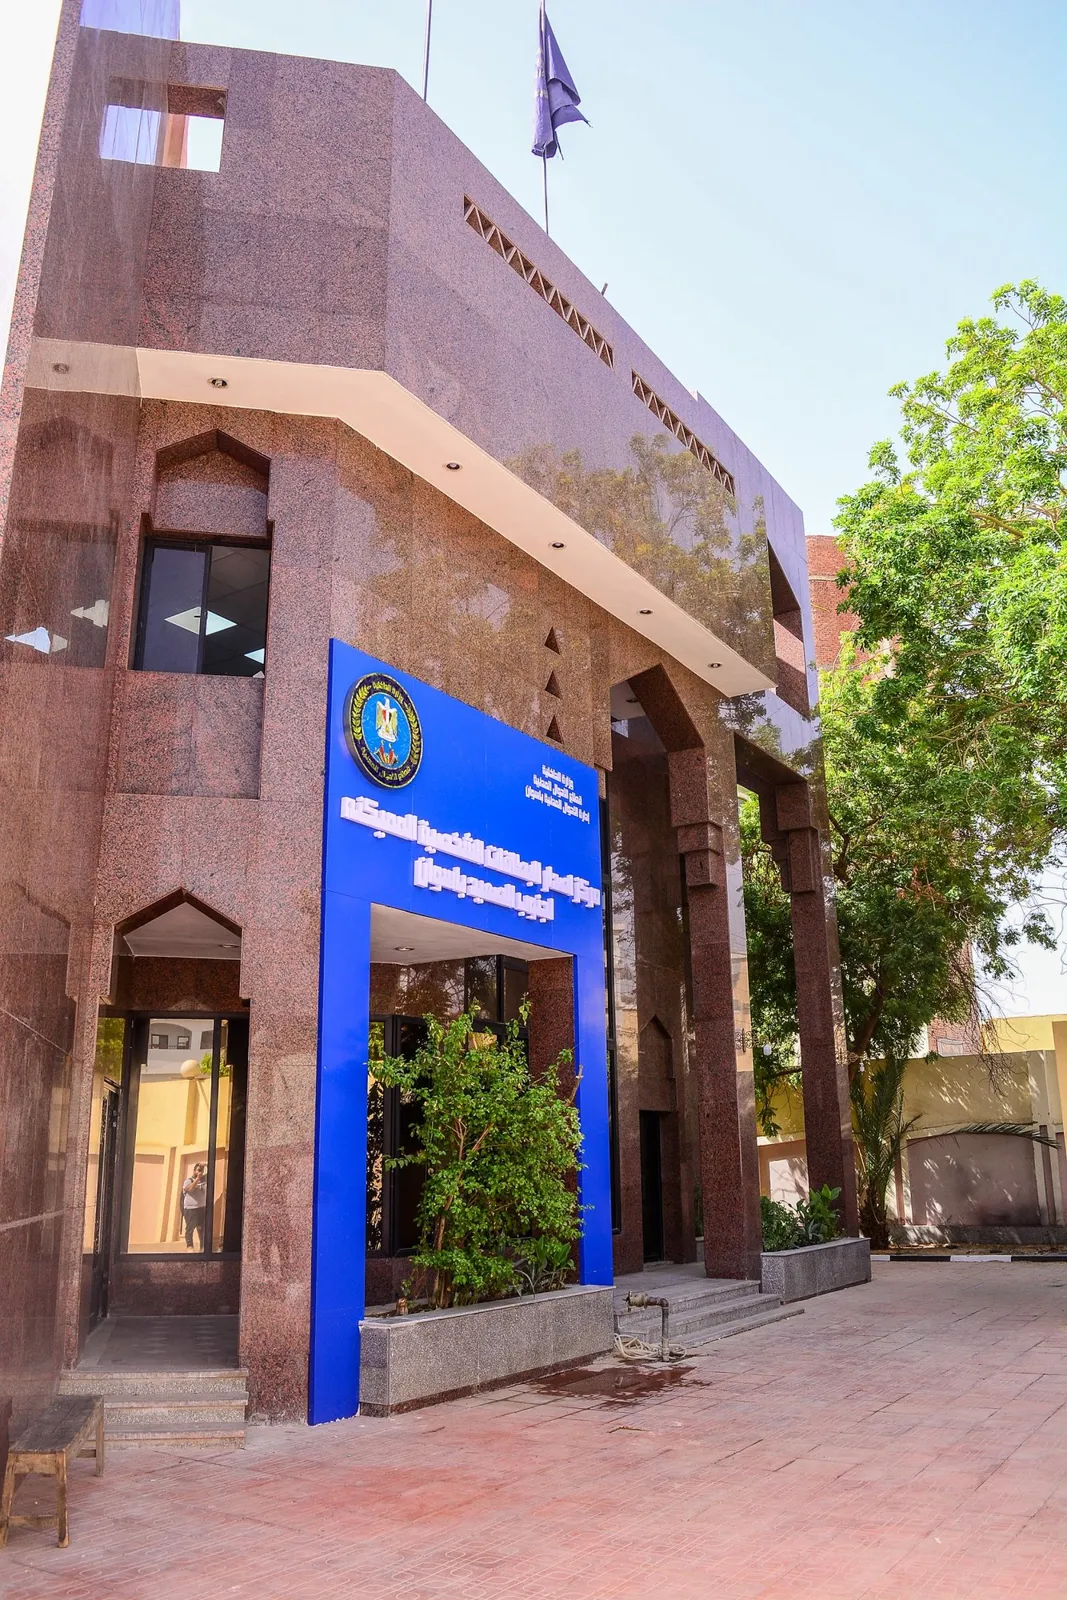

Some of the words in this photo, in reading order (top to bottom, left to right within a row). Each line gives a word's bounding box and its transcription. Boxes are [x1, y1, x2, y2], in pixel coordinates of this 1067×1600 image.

[417, 819, 484, 867] الشخصية
[483, 845, 542, 887] البطاقات
[466, 876, 516, 909] الصعيد
[515, 892, 554, 923] لجنوب
[572, 876, 600, 908] مركز
